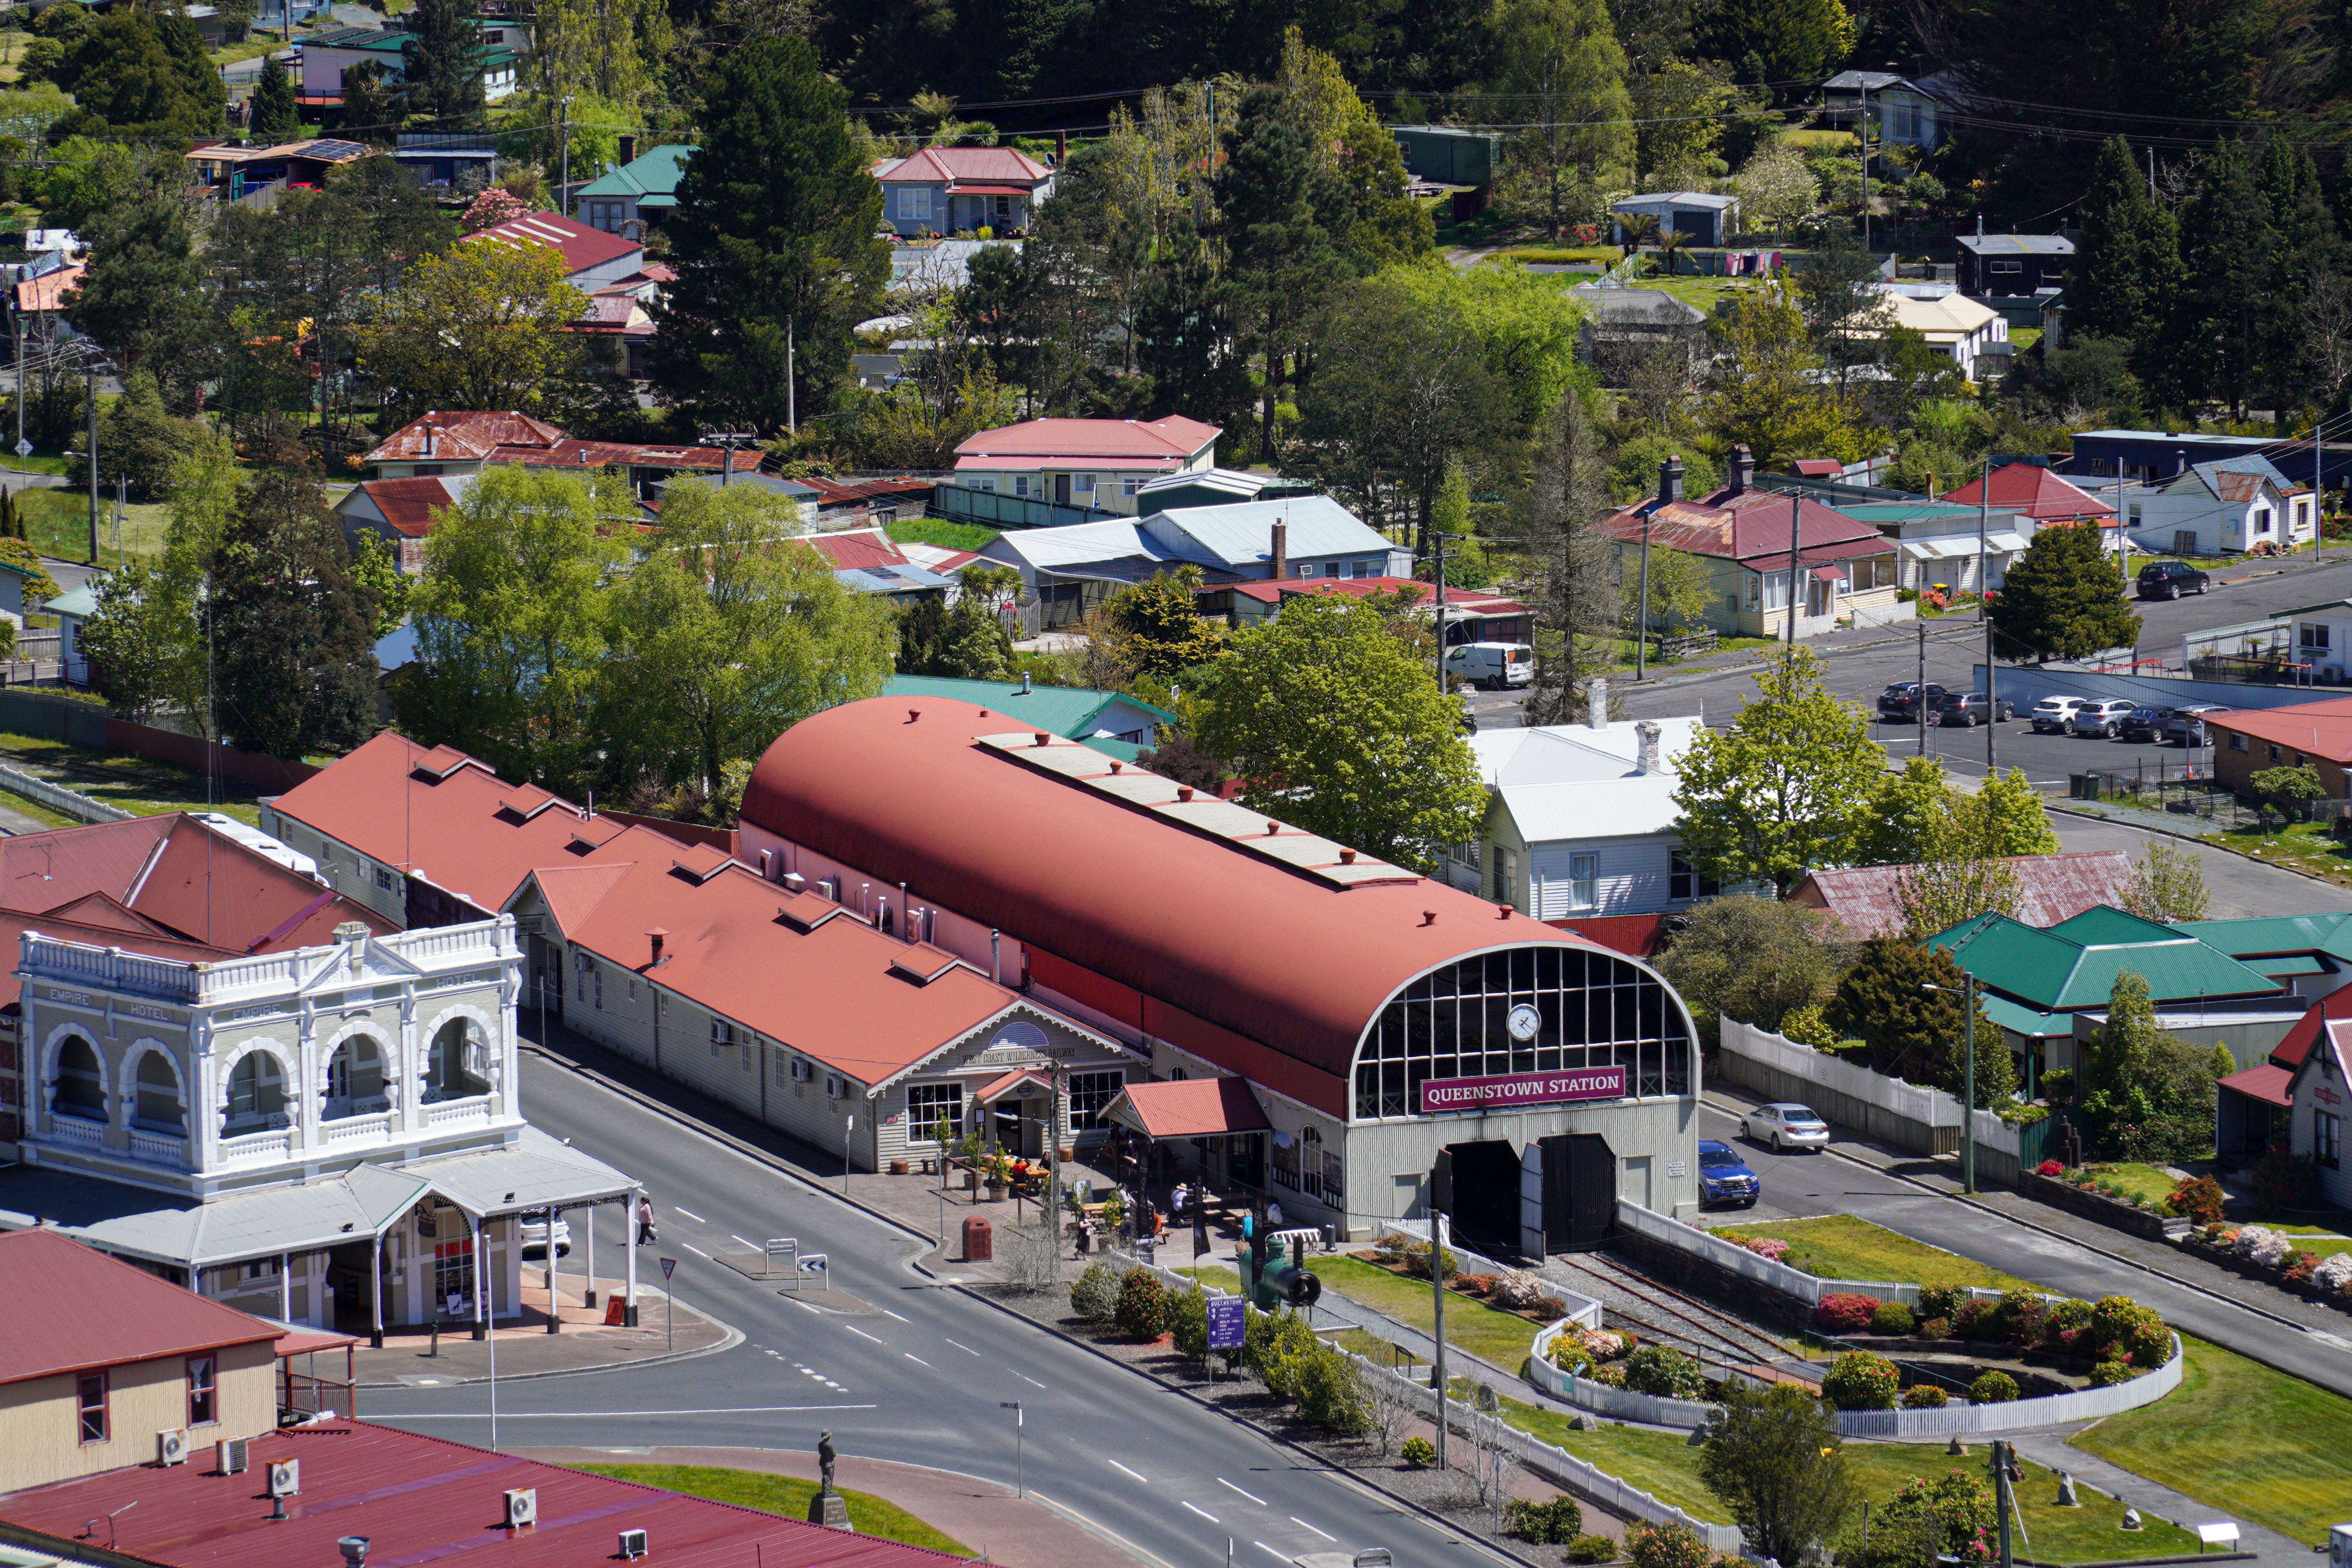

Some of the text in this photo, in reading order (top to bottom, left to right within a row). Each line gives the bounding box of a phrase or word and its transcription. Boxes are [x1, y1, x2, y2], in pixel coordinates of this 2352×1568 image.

[50, 988, 168, 1021] EMPIRE HOTEL
[233, 973, 480, 1021] EMPIRE HOTEL
[962, 1047, 1076, 1064] WEST COAST WILDERNESS RAILWAY
[1429, 1076, 1619, 1105] QUEENSTOWN STATION
